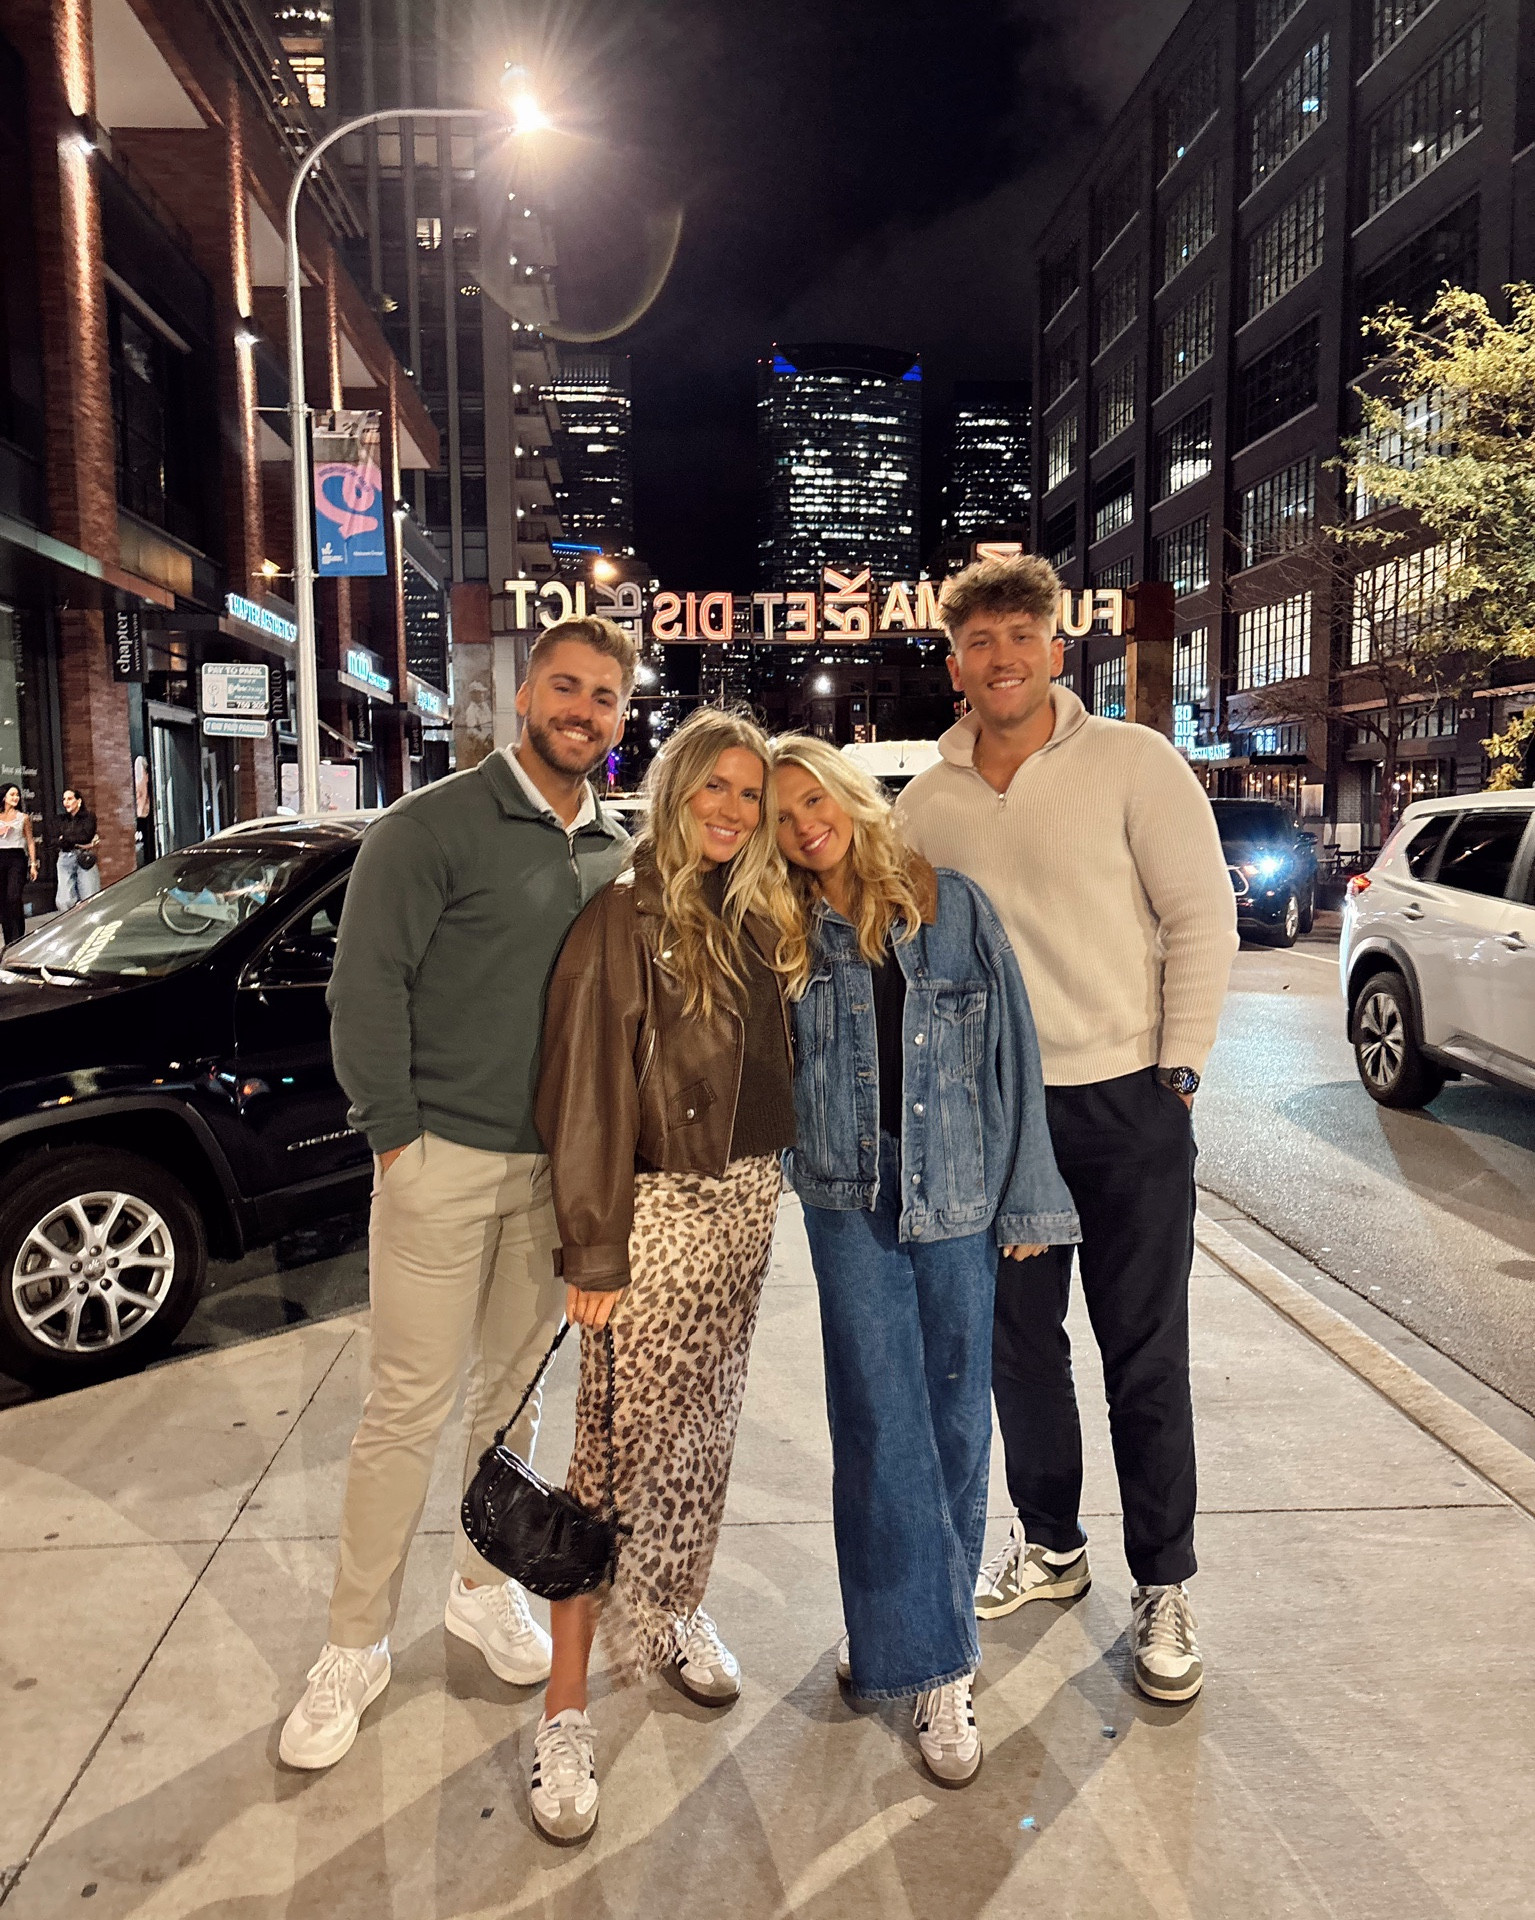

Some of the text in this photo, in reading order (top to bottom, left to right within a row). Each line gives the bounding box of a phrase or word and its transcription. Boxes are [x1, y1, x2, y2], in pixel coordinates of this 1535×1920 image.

[116, 612, 133, 674] chapter
[207, 666, 262, 675] PAY TO PARK
[1174, 705, 1192, 720] BO
[1174, 721, 1199, 736] QUE
[287, 1128, 358, 1151] CHEROK
